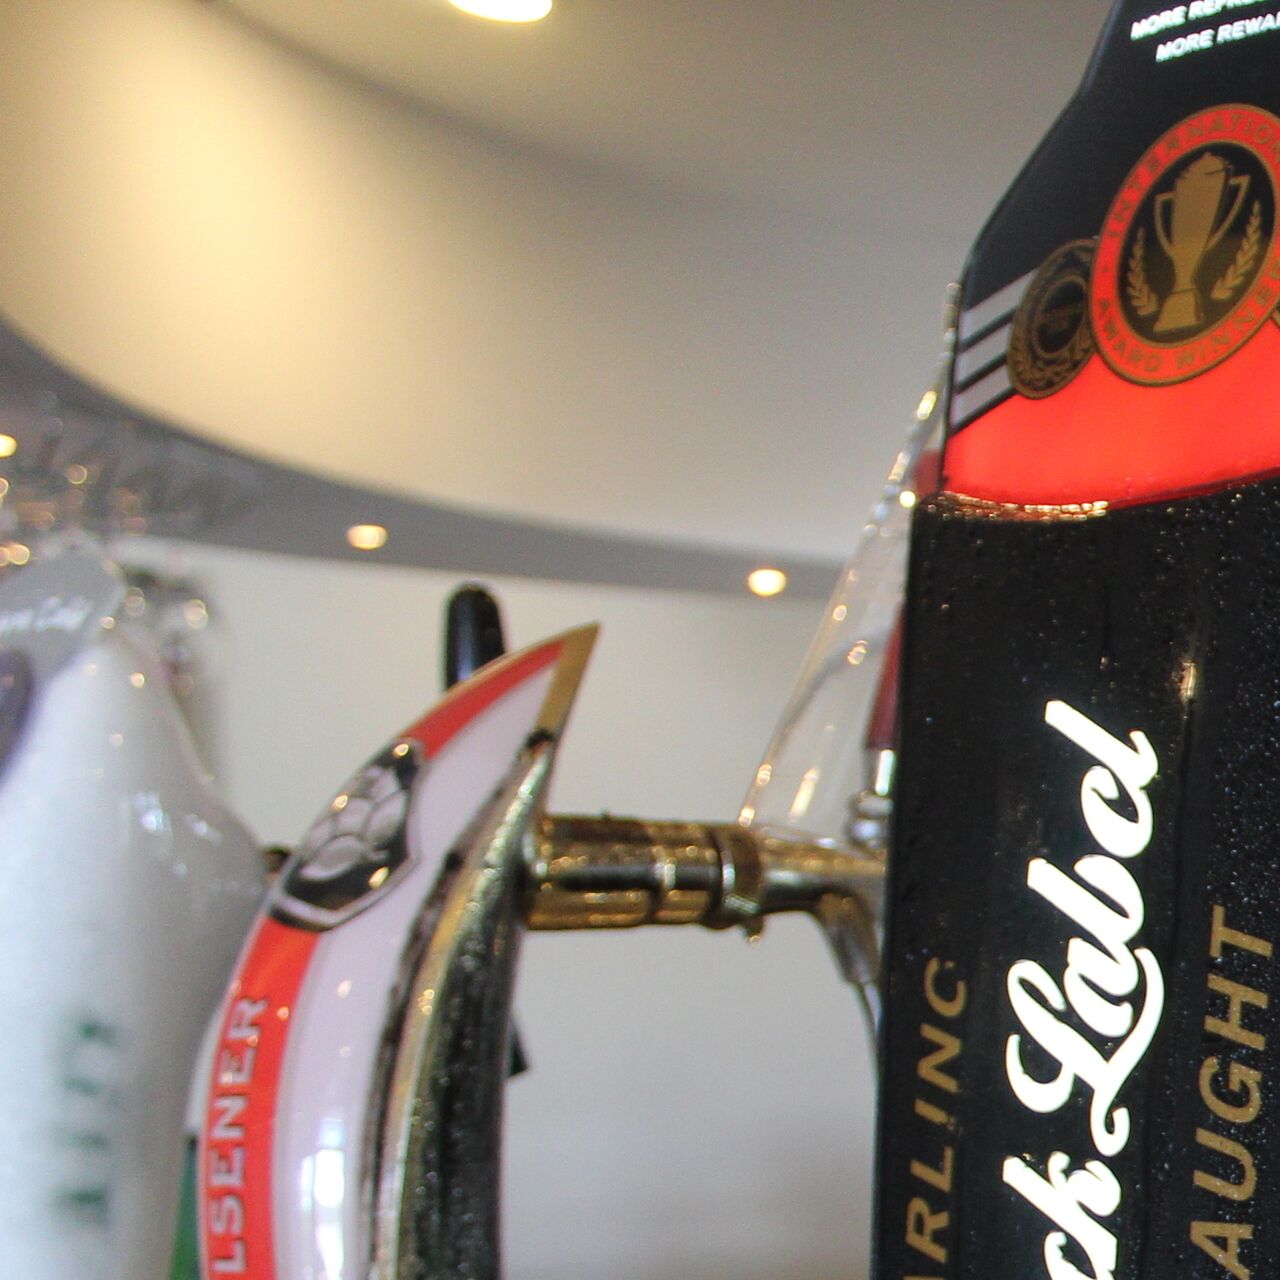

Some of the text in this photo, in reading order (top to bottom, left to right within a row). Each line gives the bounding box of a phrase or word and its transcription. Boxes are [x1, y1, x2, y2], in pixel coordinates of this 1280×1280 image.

[1130, 5, 1187, 41] MORE
[1155, 28, 1215, 62] MORE
[1099, 299, 1165, 372] AWARD
[1006, 698, 1165, 1158] Label
